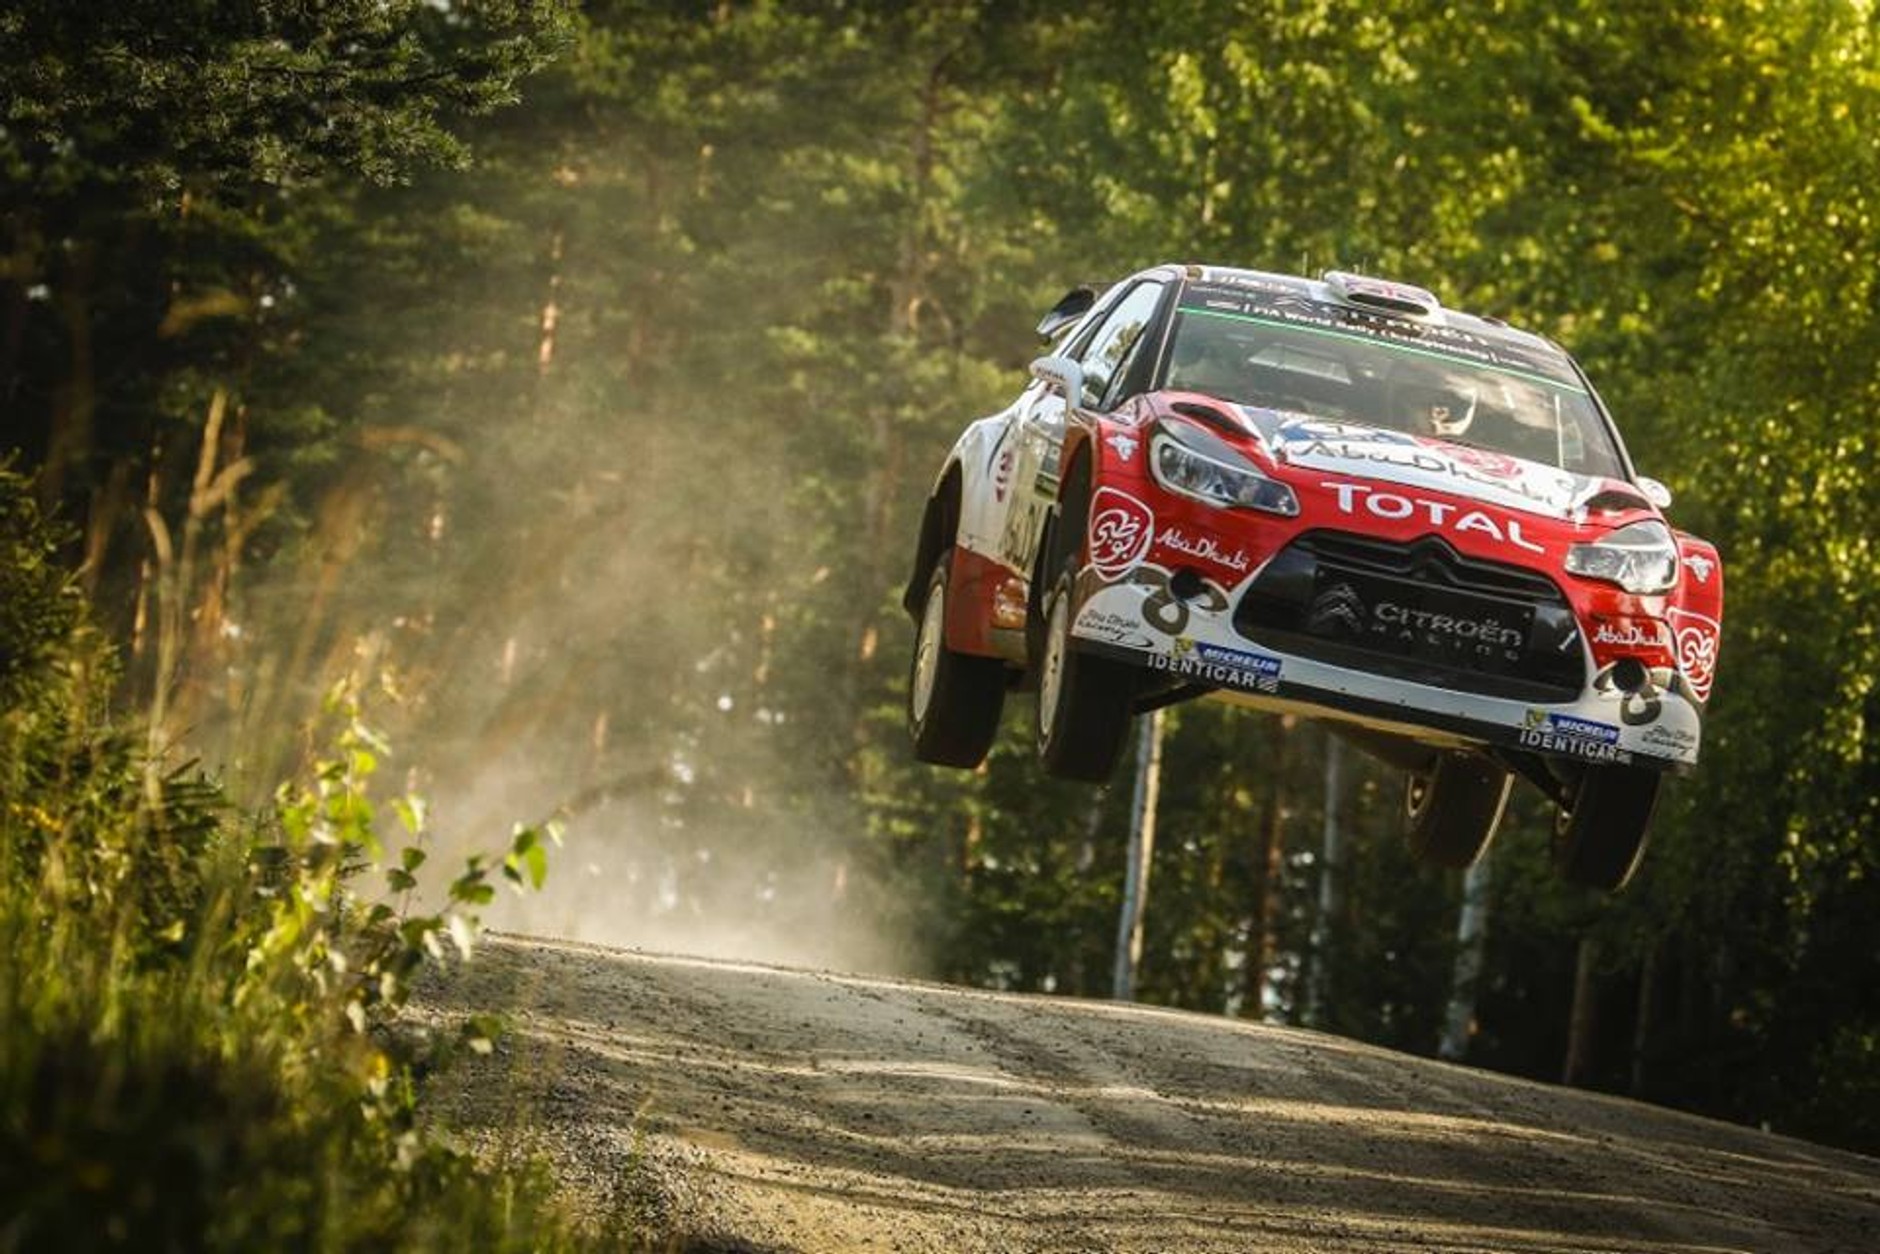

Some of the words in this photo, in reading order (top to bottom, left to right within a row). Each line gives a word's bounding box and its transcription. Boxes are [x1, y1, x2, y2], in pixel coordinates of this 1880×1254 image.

[1320, 481, 1545, 553] TOTAL
[1146, 653, 1256, 688] IDENTICAR
[1202, 648, 1278, 673] MICHELIN
[1519, 729, 1617, 762] IDENTICAR
[1556, 718, 1617, 741] MICHELIN
